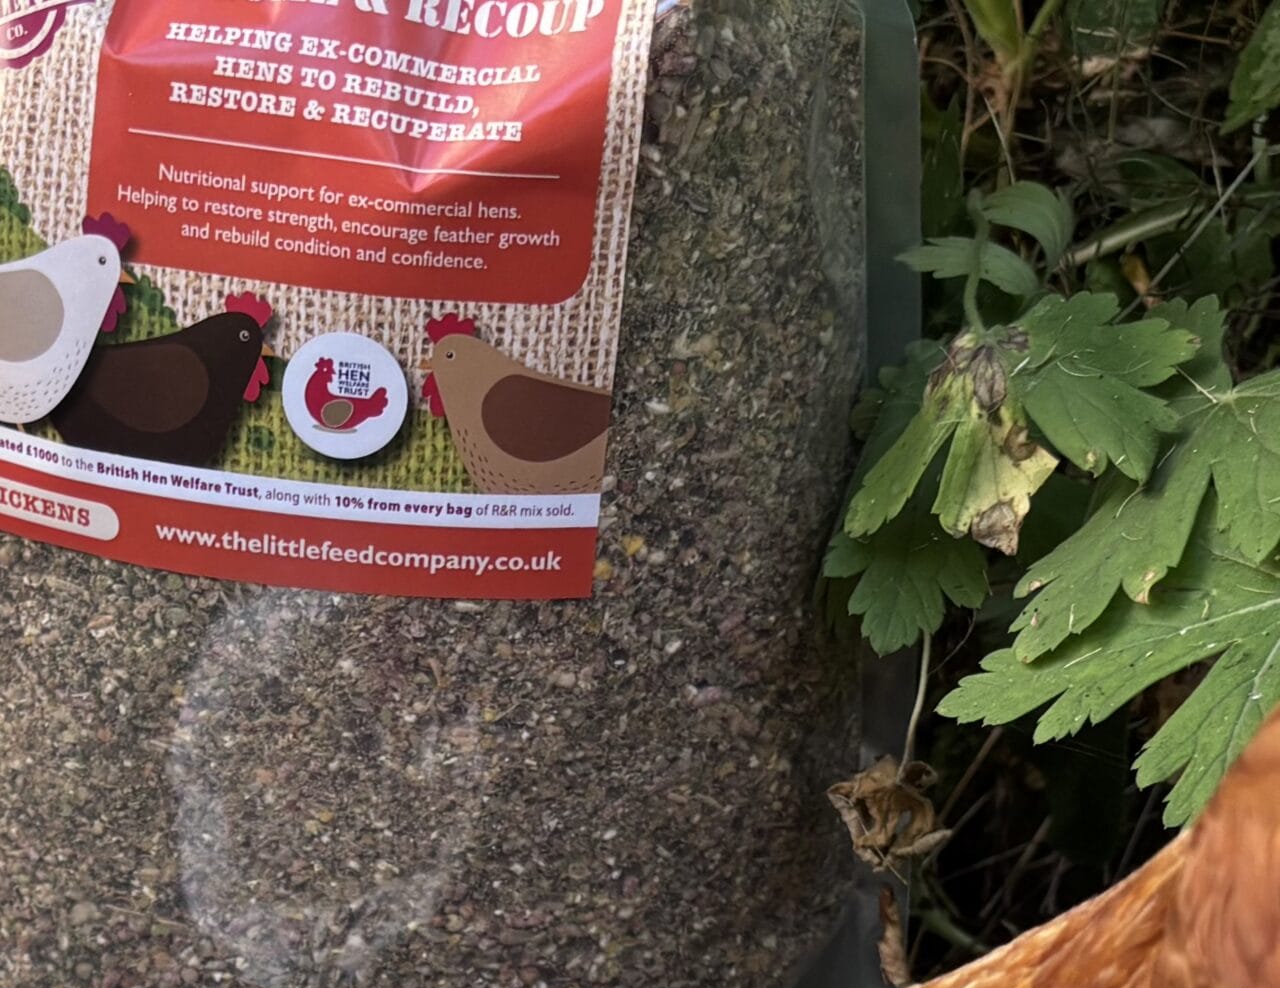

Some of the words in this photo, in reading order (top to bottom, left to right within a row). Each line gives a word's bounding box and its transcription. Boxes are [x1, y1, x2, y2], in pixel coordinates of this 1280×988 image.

[6, 24, 28, 40] CO.
[404, 0, 604, 38] RECOUP
[165, 22, 292, 53] HELPING
[298, 35, 541, 86] EX-COMMERCIAL
[169, 82, 296, 117] RESTORE
[302, 100, 325, 121] &
[331, 103, 522, 142] RECUPERATE
[213, 56, 294, 85] HENS
[300, 67, 336, 91] TO
[342, 73, 480, 119] REBUILD,
[158, 163, 246, 192] Nutritional
[250, 179, 315, 201] support
[319, 185, 344, 205] for
[348, 194, 472, 218] ex-commercial
[477, 201, 522, 219] hens.
[117, 184, 177, 213] Helping
[181, 197, 199, 211] to
[204, 200, 263, 220] restore
[267, 208, 338, 233] strength,
[341, 218, 428, 245] encourage
[433, 225, 494, 244] feather
[498, 230, 560, 249] growth
[181, 222, 210, 240] and
[214, 226, 270, 248] rebuild
[274, 237, 351, 260] condition
[356, 246, 386, 263] and
[392, 250, 488, 269] confidence.
[338, 361, 371, 370] BRITISH
[338, 369, 371, 382] HEN
[338, 380, 369, 388] WELFARE
[337, 386, 370, 396] TRUST
[26, 445, 59, 464] £1000
[61, 456, 73, 468] to
[75, 458, 94, 472] the
[96, 462, 139, 481] British
[141, 471, 167, 485] Hen
[170, 475, 221, 493] Welfare
[224, 482, 262, 500] Trust,
[265, 488, 300, 506] along
[303, 493, 331, 507] with
[335, 495, 364, 509] 10%
[367, 498, 401, 513] from
[404, 504, 443, 518] every
[446, 502, 472, 519] bag
[476, 501, 489, 516] of
[492, 504, 517, 516] R&R
[520, 503, 543, 516] mix
[546, 501, 574, 517] sold.
[155, 523, 562, 575] www.thelittlefeedcompany.co.uk
